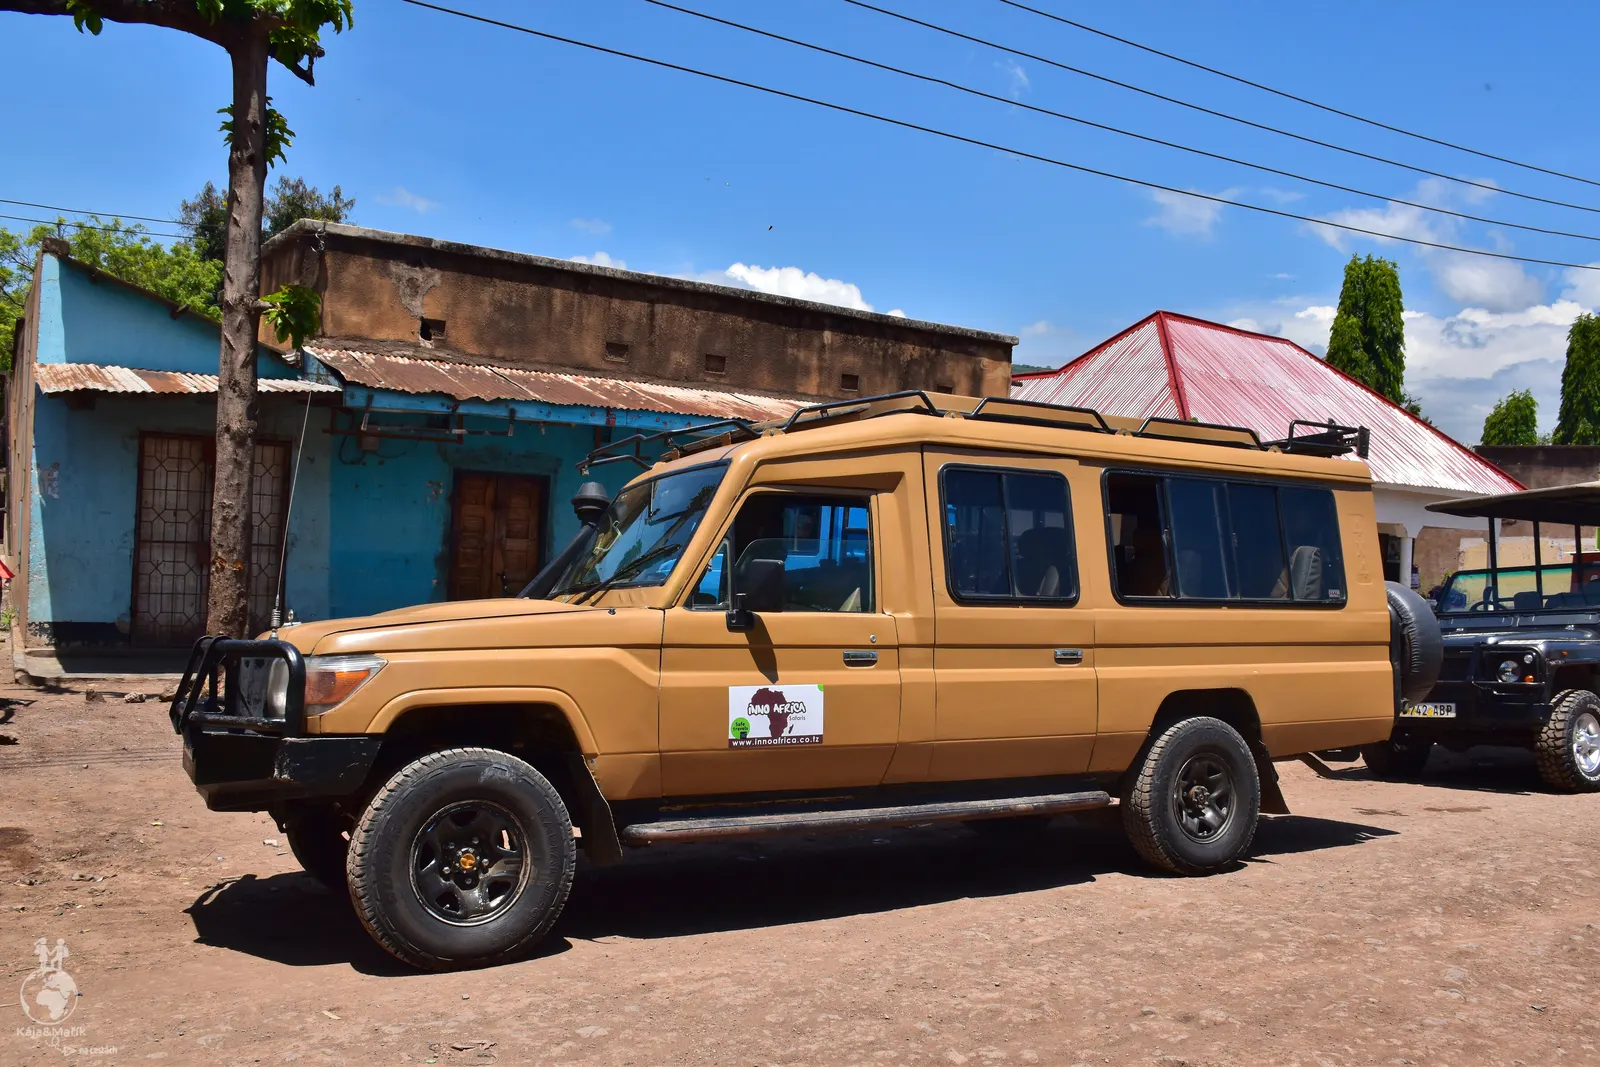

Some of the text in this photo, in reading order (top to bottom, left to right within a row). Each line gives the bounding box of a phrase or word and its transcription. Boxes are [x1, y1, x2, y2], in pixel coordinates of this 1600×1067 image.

[1402, 704, 1452, 716] 742 ABP
[732, 736, 820, 746] www.innoafrica.co.tz
